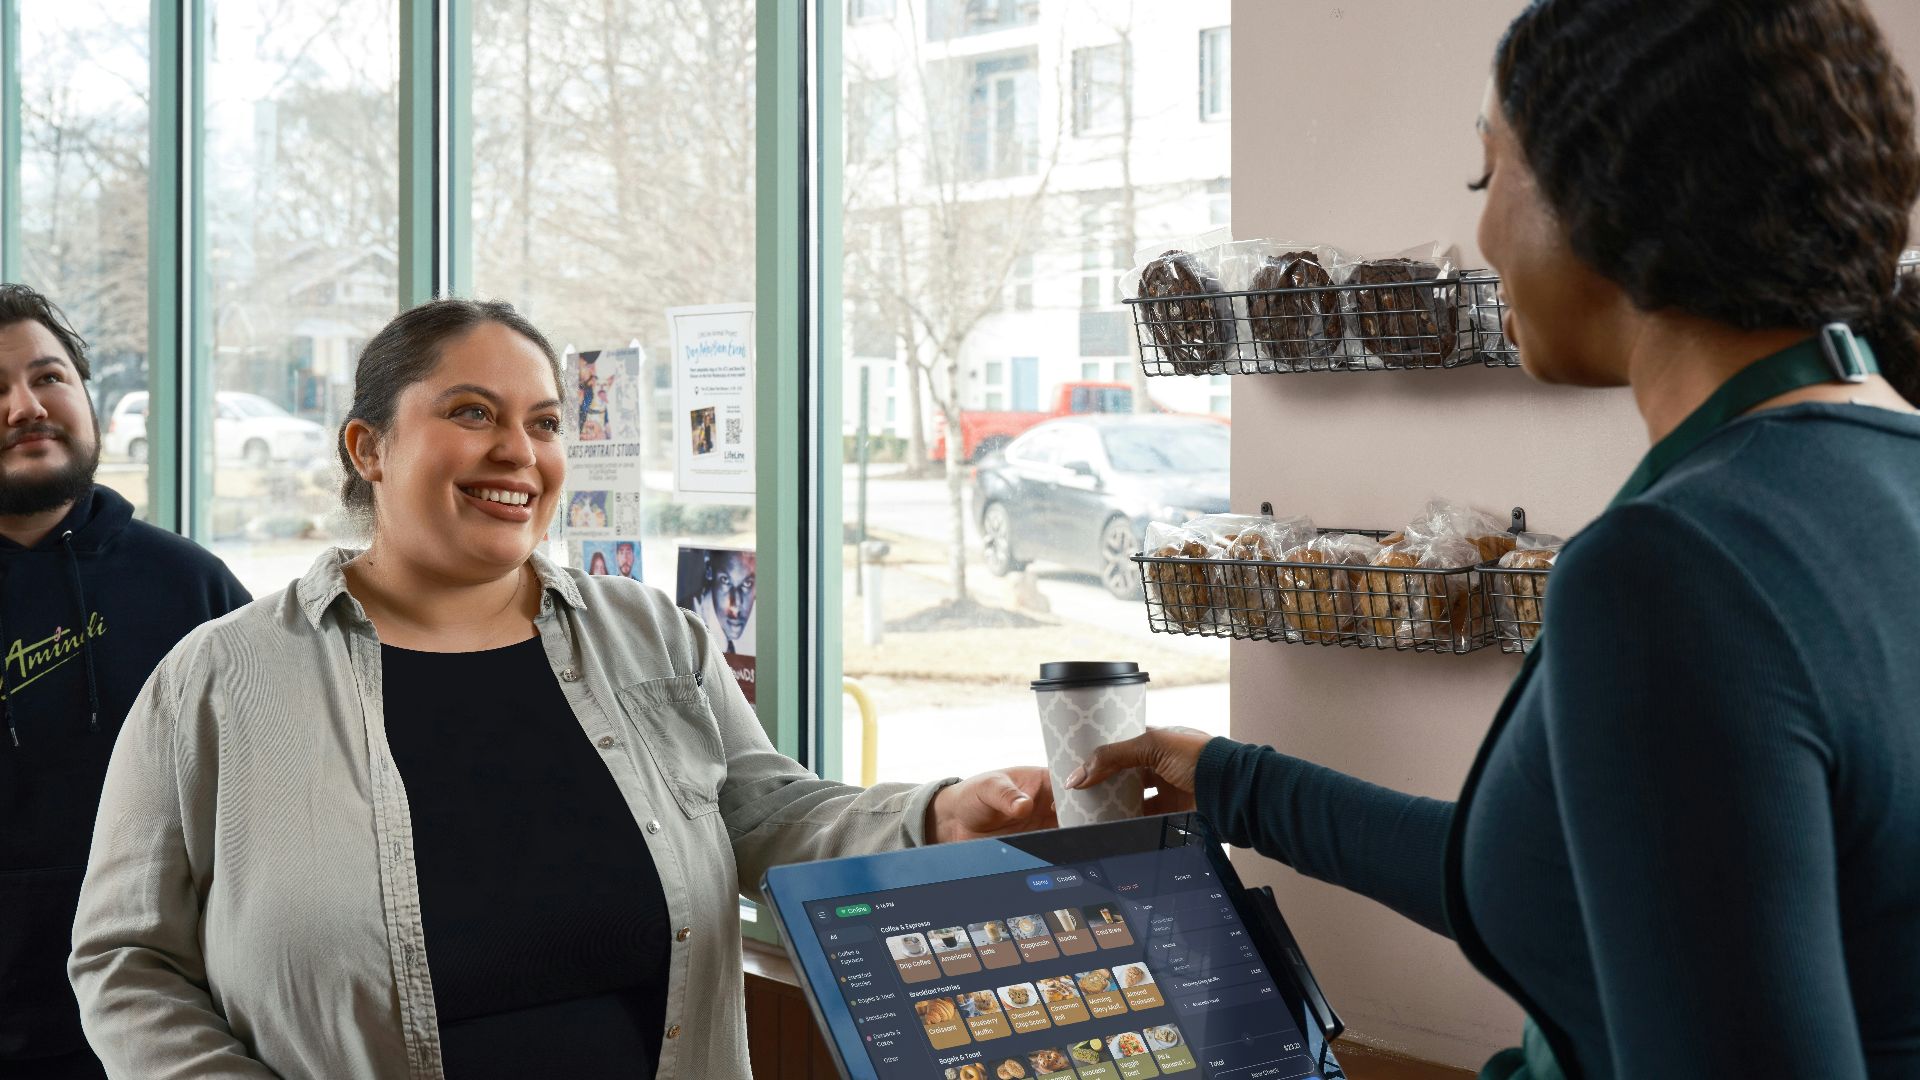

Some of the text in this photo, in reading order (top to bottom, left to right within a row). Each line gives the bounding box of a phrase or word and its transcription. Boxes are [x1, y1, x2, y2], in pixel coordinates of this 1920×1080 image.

[728, 340, 746, 358] Event
[568, 442, 640, 458] CATS PORTRAIT STUDIO
[724, 451, 744, 460] LifeLine
[904, 921, 930, 930] Espresso
[942, 953, 972, 962] Americano
[899, 959, 931, 970] Drip Coffee
[1127, 989, 1147, 998] Almond
[1088, 996, 1112, 1004] Morning
[1130, 996, 1156, 1006] Croissant
[1050, 1003, 1079, 1012] Cinnamon
[1011, 1010, 1040, 1020] Chocolate
[970, 1018, 998, 1028] Blueberry
[928, 1025, 956, 1034] Croissant
[975, 1028, 994, 1036] Muffin
[938, 1055, 960, 1065] Bagels
[964, 1050, 982, 1058] Toast
[1120, 1060, 1140, 1068] Veggie
[1162, 1060, 1183, 1069] Banana
[1209, 1059, 1224, 1068] Total
[1082, 1067, 1106, 1076] Avocado
